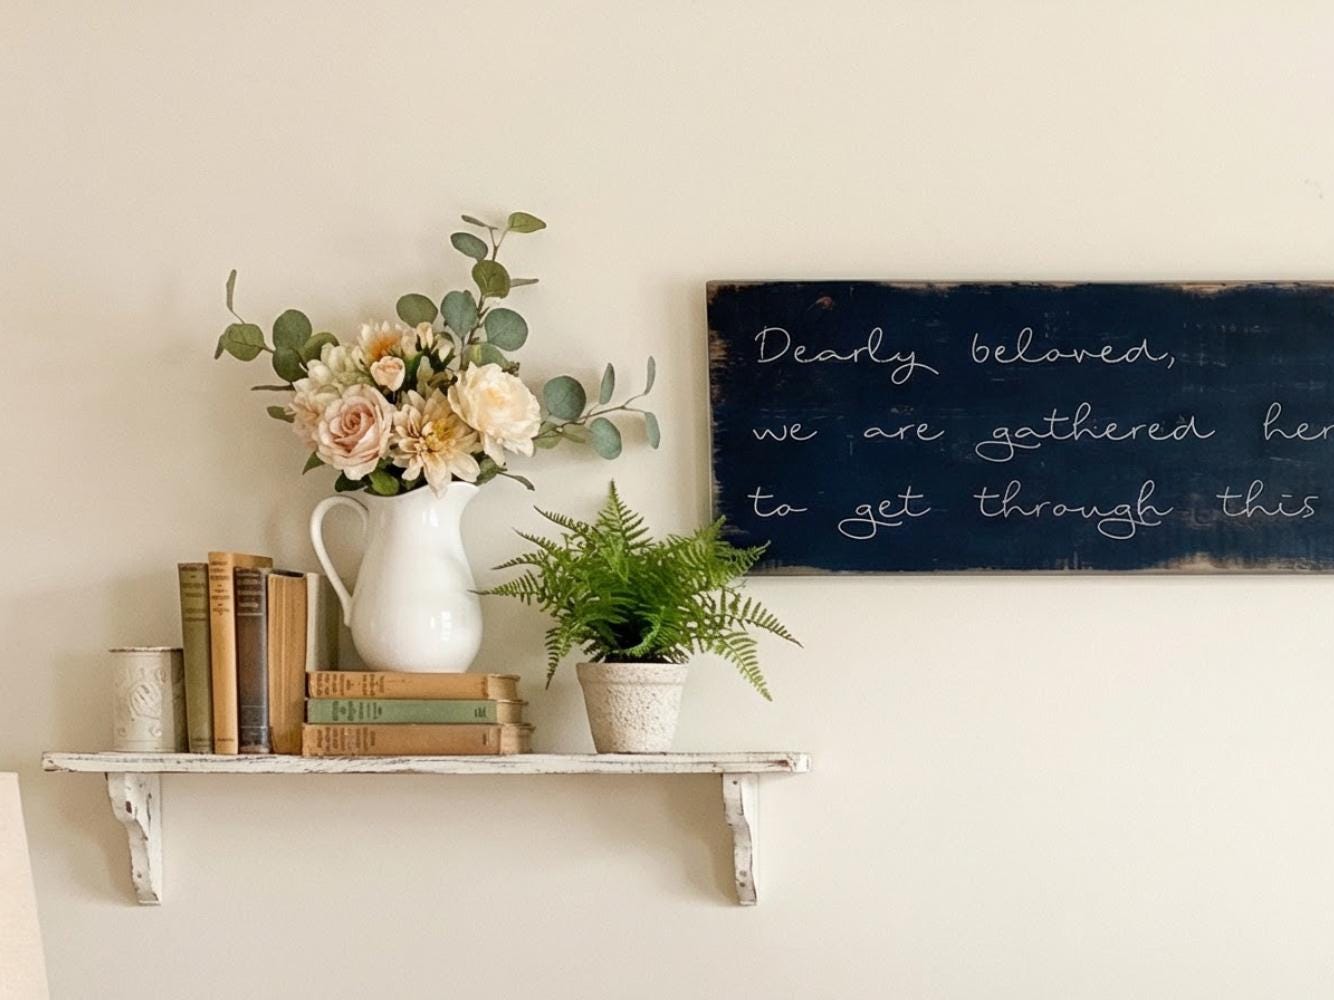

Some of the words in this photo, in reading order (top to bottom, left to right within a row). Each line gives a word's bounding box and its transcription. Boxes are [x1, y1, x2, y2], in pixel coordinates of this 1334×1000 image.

[755, 327, 939, 385] Dearly
[971, 327, 1175, 369] beloved,
[752, 422, 818, 442] we
[863, 422, 945, 441] are
[975, 402, 1216, 462] gathered
[747, 486, 808, 518] to
[838, 486, 931, 540] get
[973, 479, 1174, 540] through
[1216, 479, 1319, 518] this
